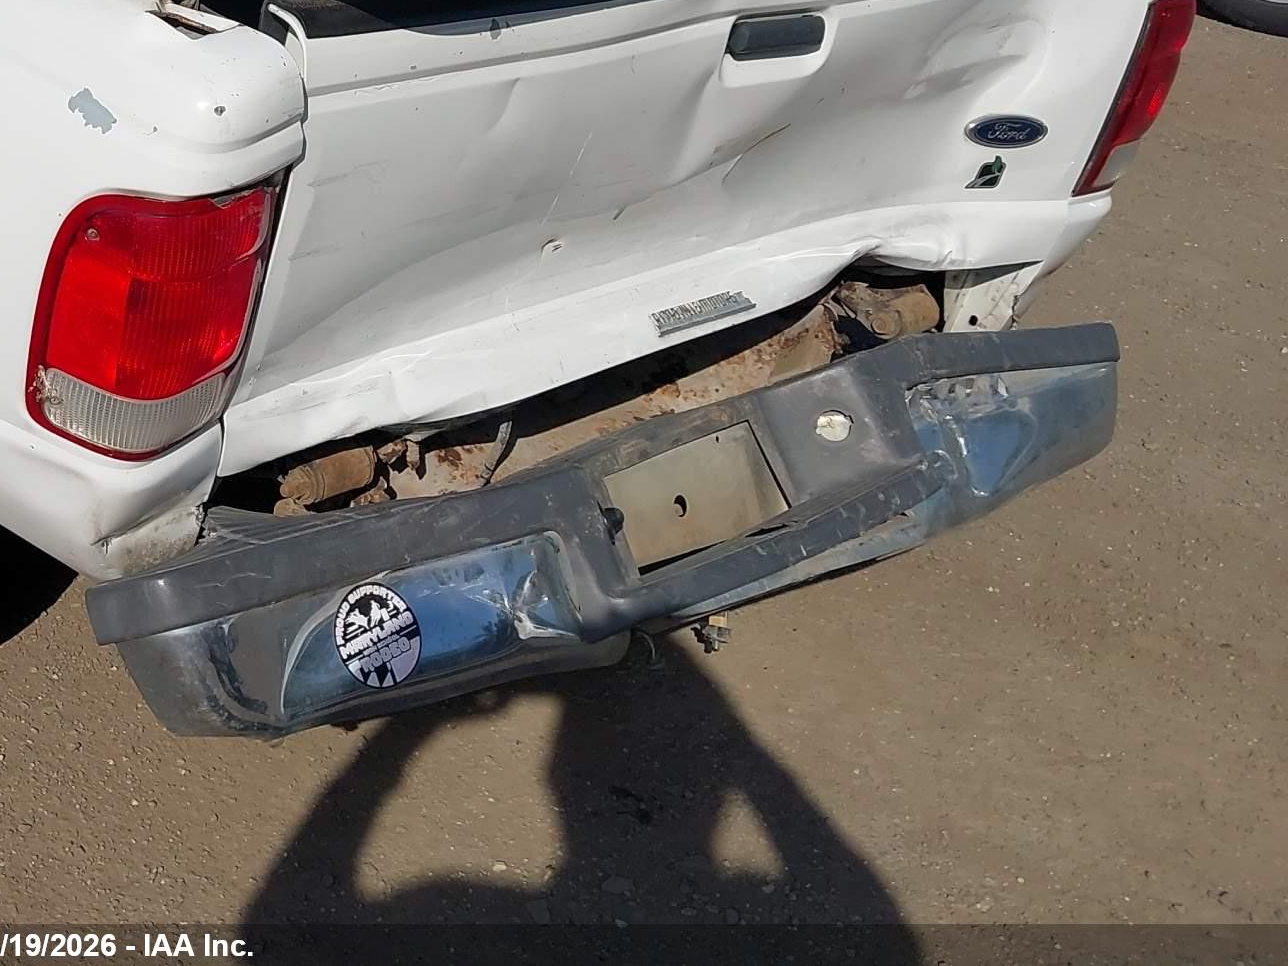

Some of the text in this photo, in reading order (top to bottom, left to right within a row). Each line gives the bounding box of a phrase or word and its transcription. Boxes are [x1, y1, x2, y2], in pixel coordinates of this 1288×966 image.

[987, 121, 1031, 140] Ford
[335, 584, 408, 646] PROUD SUPPORTER
[338, 610, 414, 659] MARYLAND
[358, 636, 411, 673] RODEO
